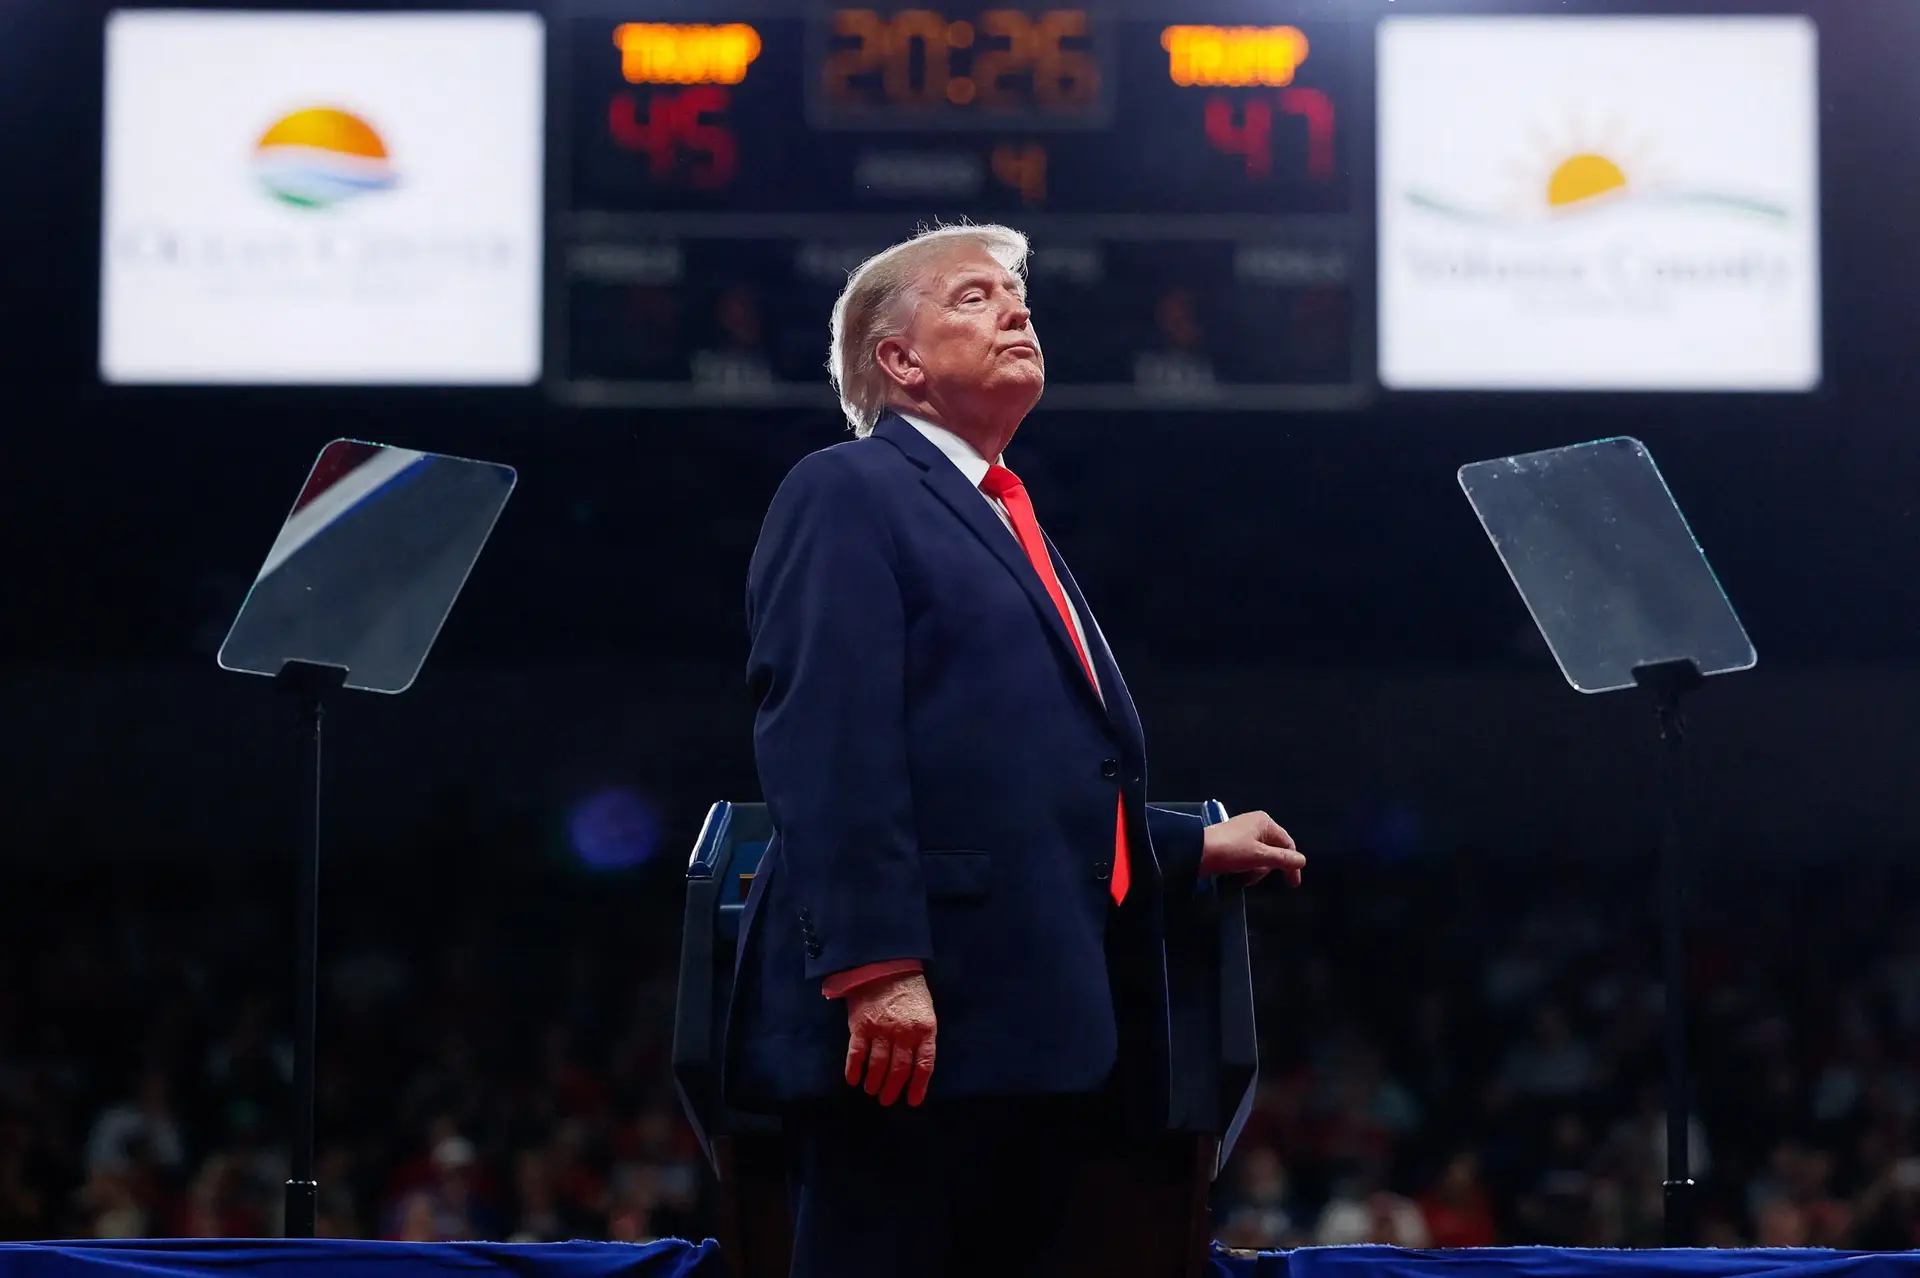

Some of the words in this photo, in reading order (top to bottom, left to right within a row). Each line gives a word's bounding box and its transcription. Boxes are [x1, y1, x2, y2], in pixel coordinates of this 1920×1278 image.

[824, 9, 1100, 114] 20:26
[609, 87, 738, 189] 45
[1205, 88, 1335, 180] 47
